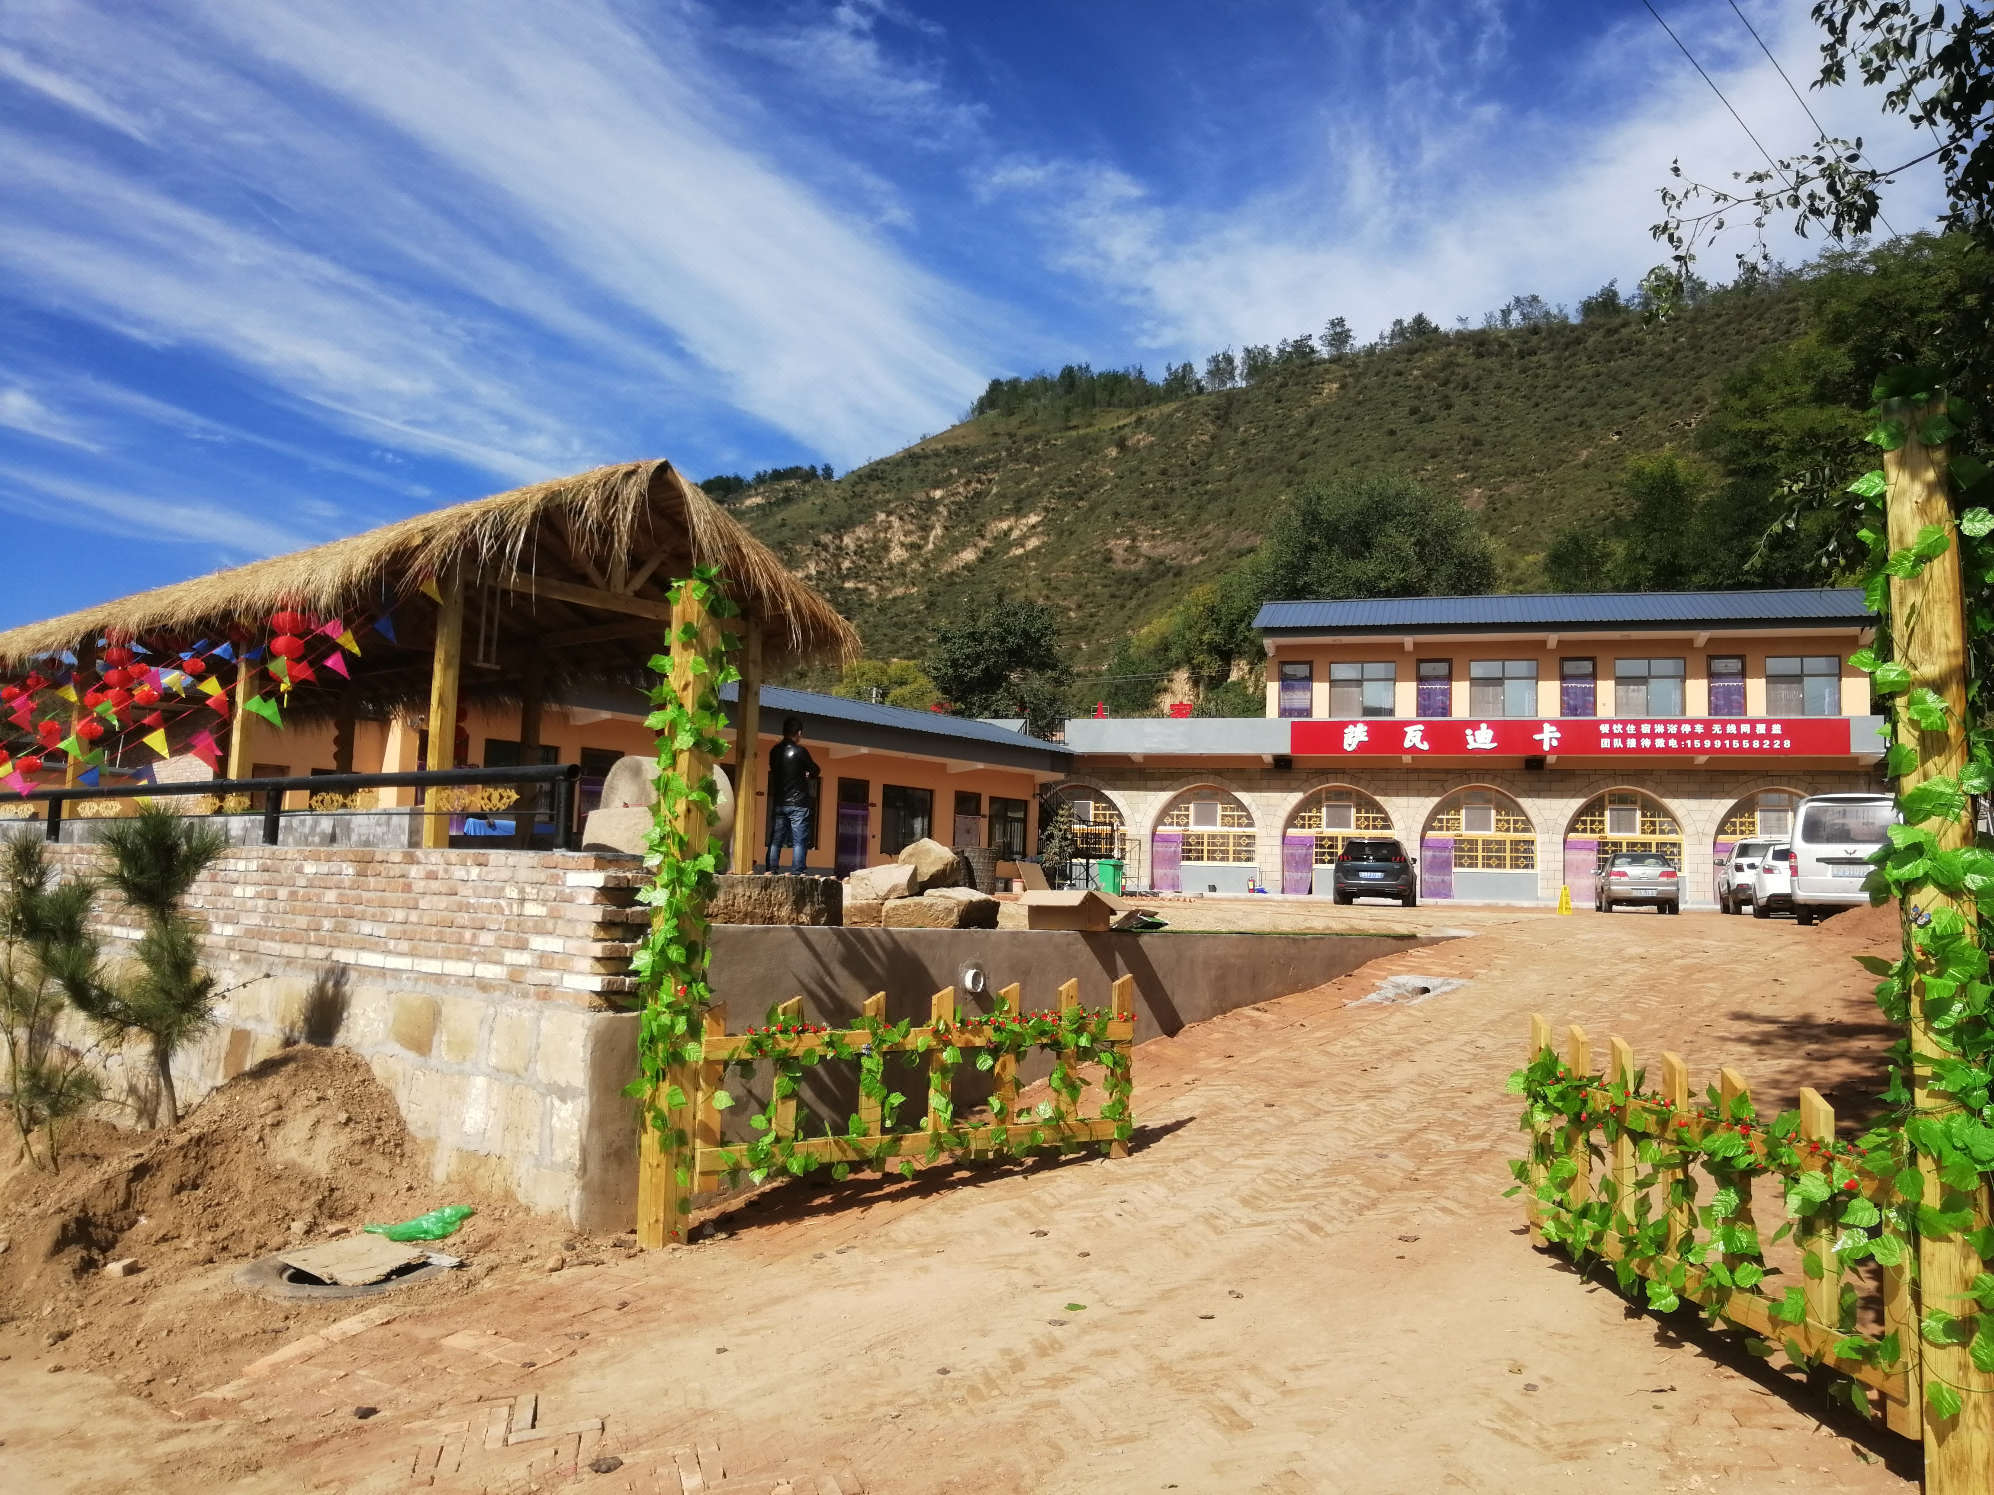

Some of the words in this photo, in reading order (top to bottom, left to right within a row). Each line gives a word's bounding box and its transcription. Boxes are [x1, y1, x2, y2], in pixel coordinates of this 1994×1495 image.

[1343, 722, 1562, 752] 萨瓦迪卡
[1599, 723, 1705, 735] 餐饮住宿淋浴停车
[1711, 723, 1782, 735] 无线网覆盖
